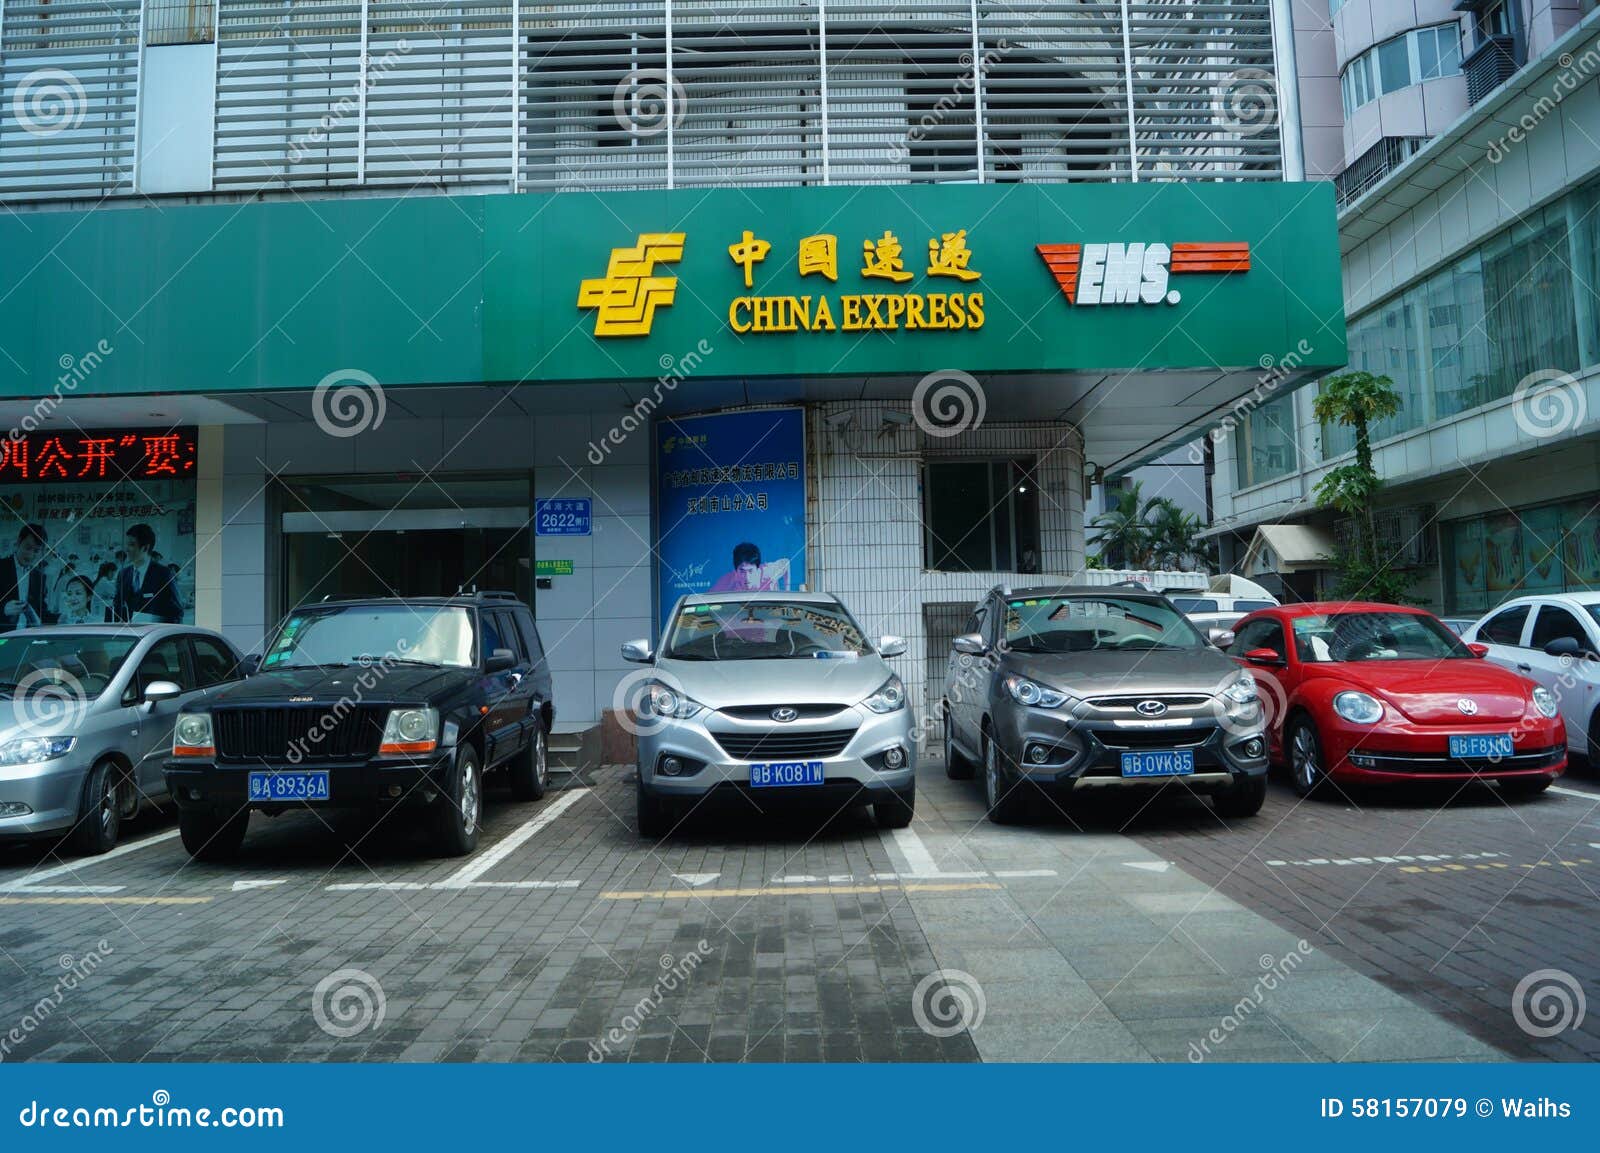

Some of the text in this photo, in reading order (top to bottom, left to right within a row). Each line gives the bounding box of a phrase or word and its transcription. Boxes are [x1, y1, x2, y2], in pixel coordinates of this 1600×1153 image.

[728, 230, 982, 288] 中国速递
[729, 293, 985, 333] CHINA EXPRESS
